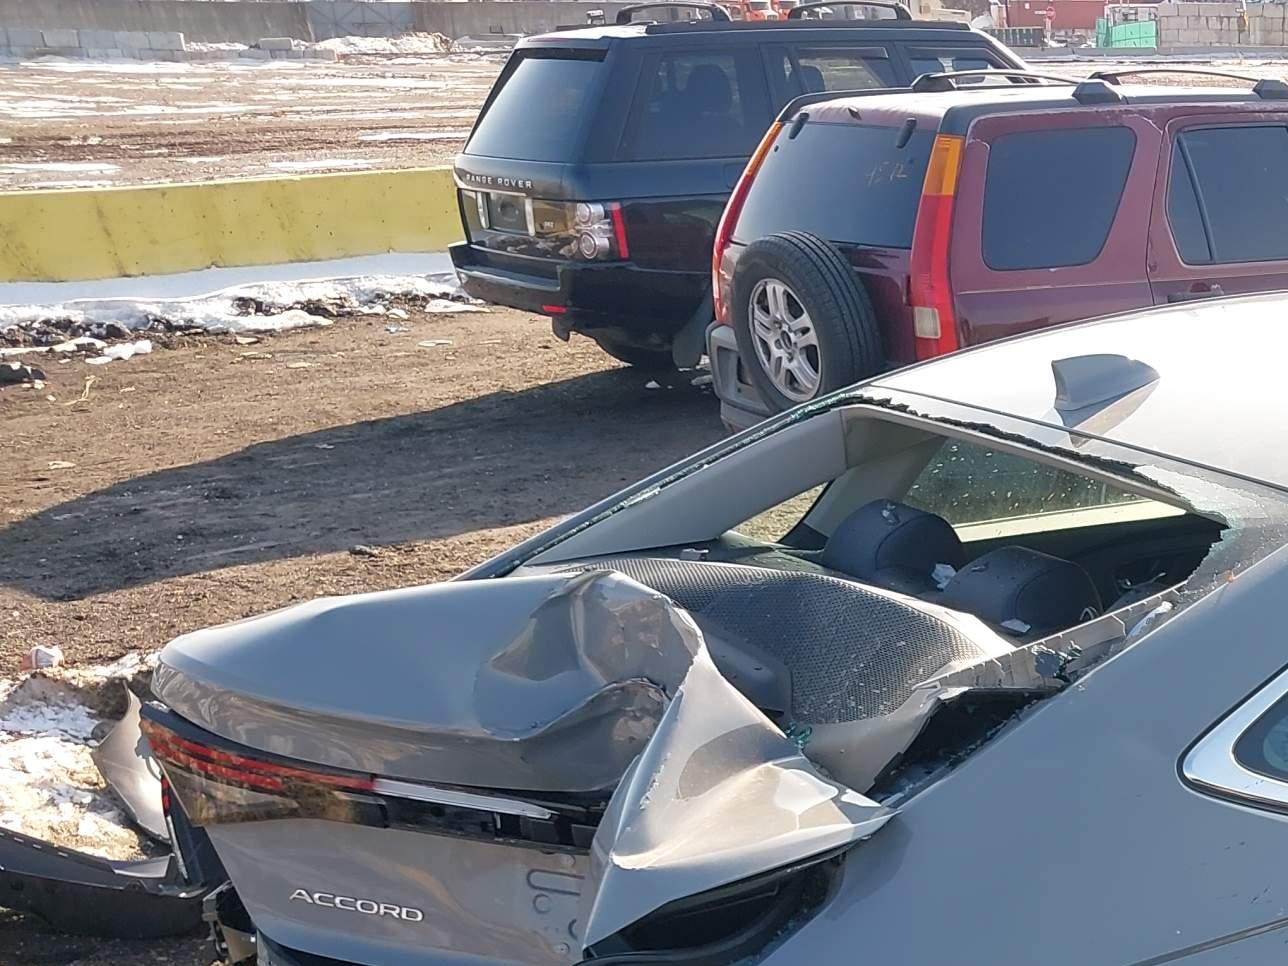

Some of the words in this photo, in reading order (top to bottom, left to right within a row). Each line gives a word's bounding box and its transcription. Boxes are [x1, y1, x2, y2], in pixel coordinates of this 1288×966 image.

[466, 174, 492, 185] RANGE
[498, 178, 532, 189] ROVER
[289, 889, 423, 922] ACCORD
